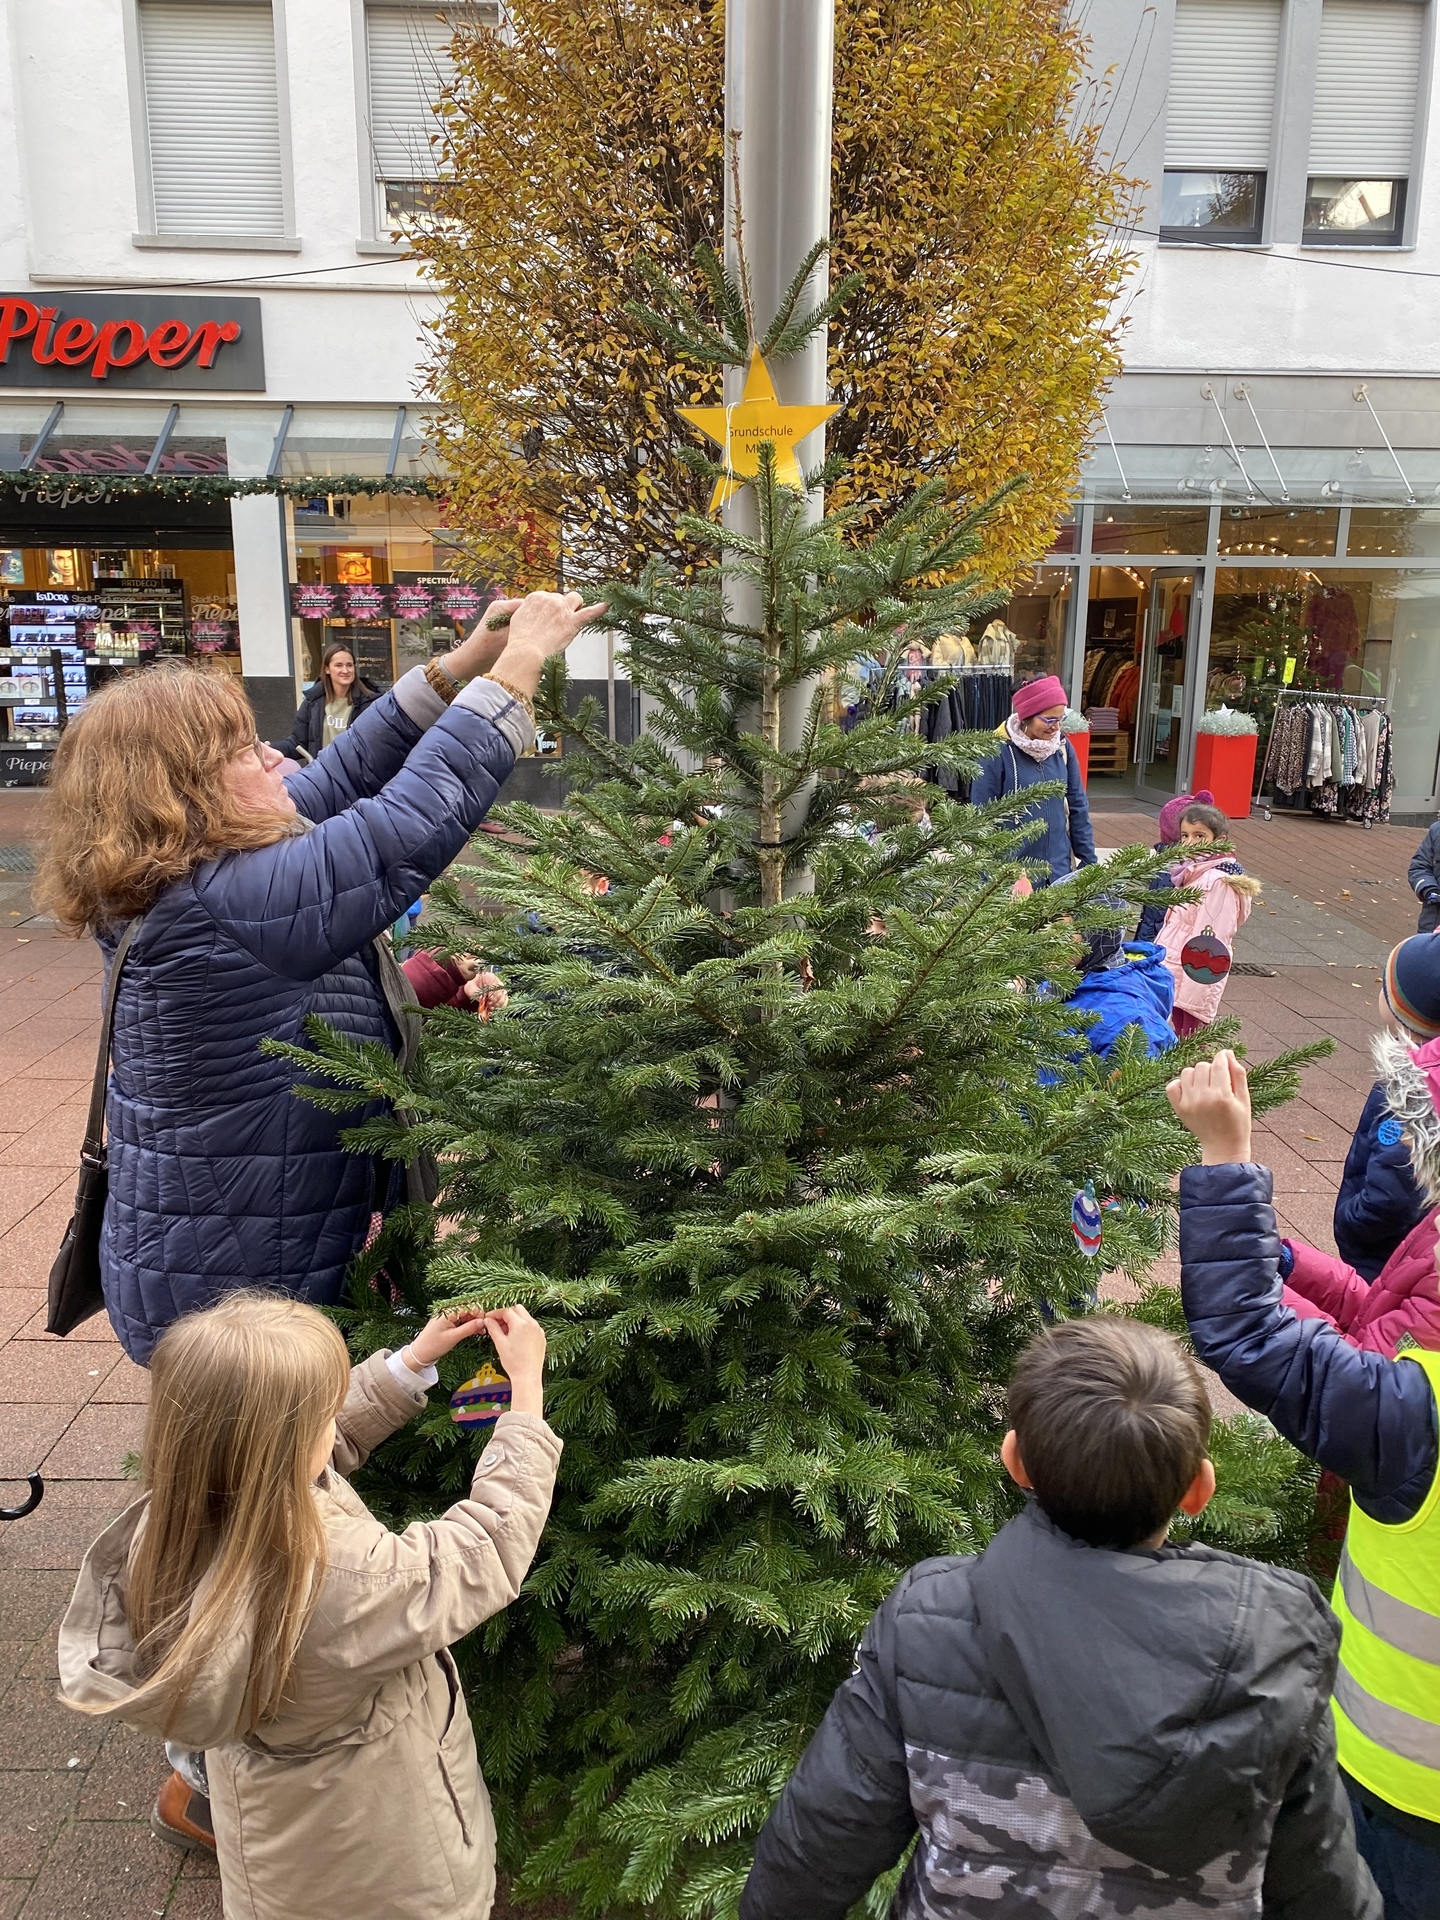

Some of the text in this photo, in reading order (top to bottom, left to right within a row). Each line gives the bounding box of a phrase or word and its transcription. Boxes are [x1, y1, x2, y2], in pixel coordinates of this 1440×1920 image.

[0, 296, 242, 378] Pieper
[728, 425, 793, 437] Grundschule
[416, 577, 460, 585] SPECTRUM
[191, 603, 239, 622] Piepe
[5, 757, 53, 774] Piepe
